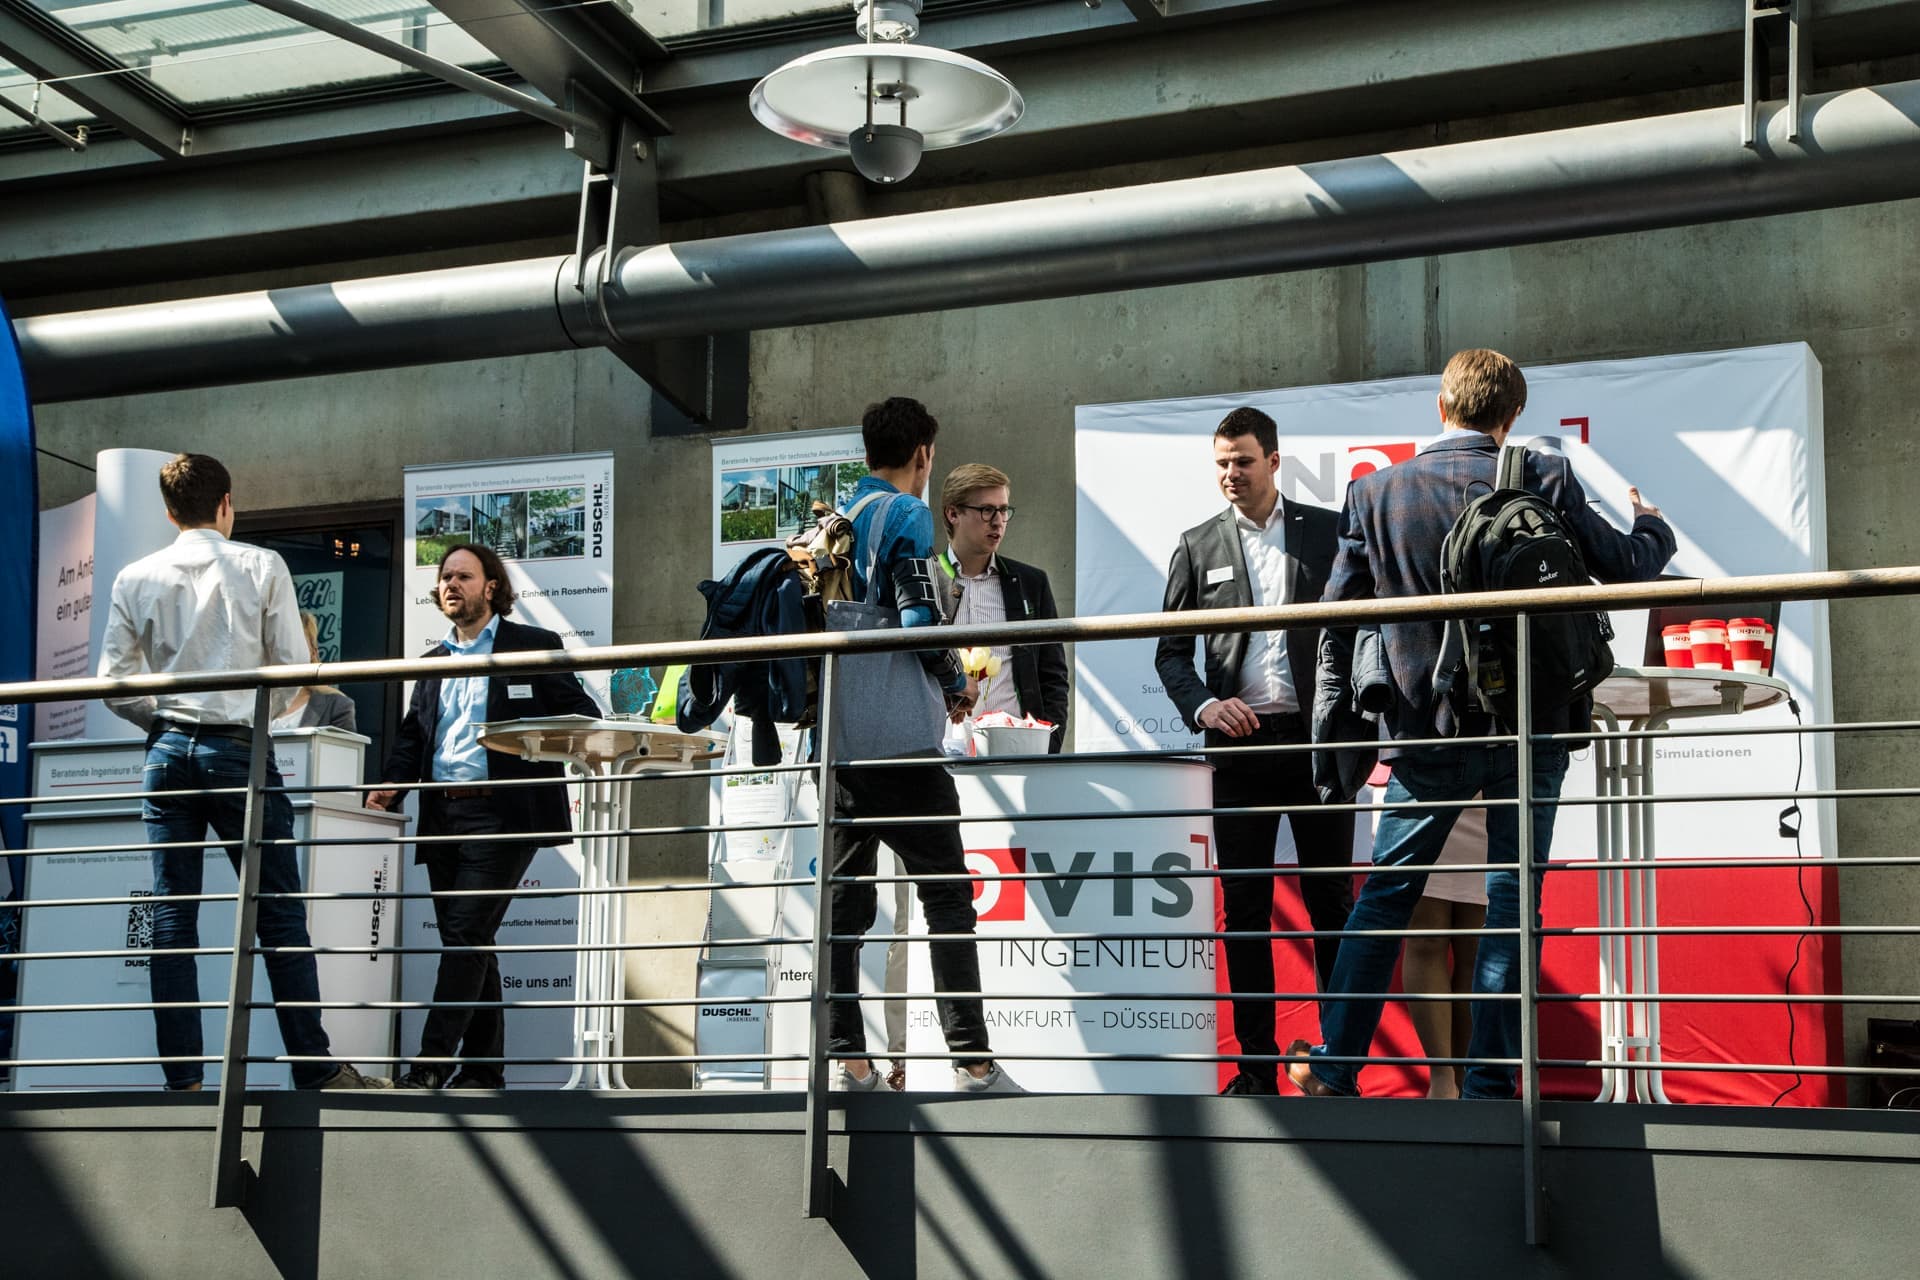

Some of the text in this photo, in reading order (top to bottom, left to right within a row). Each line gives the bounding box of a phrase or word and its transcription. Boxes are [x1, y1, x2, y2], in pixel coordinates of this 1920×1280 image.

[593, 483, 603, 558] DUSCHL
[58, 566, 75, 587] Am
[1539, 571, 1559, 583] deuter
[521, 589, 549, 598] Einheit
[552, 588, 560, 596] in
[561, 585, 608, 596] Rosenheim
[56, 599, 72, 621] ein
[560, 629, 595, 639] geführtes
[1142, 684, 1166, 694] Stud
[1115, 716, 1185, 735] ÖKOLO
[1655, 748, 1752, 759] Simulationen
[51, 768, 89, 778] Beratende
[91, 766, 131, 777] Ingenieure
[501, 919, 533, 927] erufliche
[535, 919, 560, 927] Heimat
[562, 918, 574, 926] bei
[1000, 937, 1215, 970] INGENIEURE
[780, 969, 813, 981] ntere
[502, 975, 572, 988] Sie uns an!
[702, 1008, 752, 1017] DUSCHL
[985, 1010, 1076, 1028] ANKFURT
